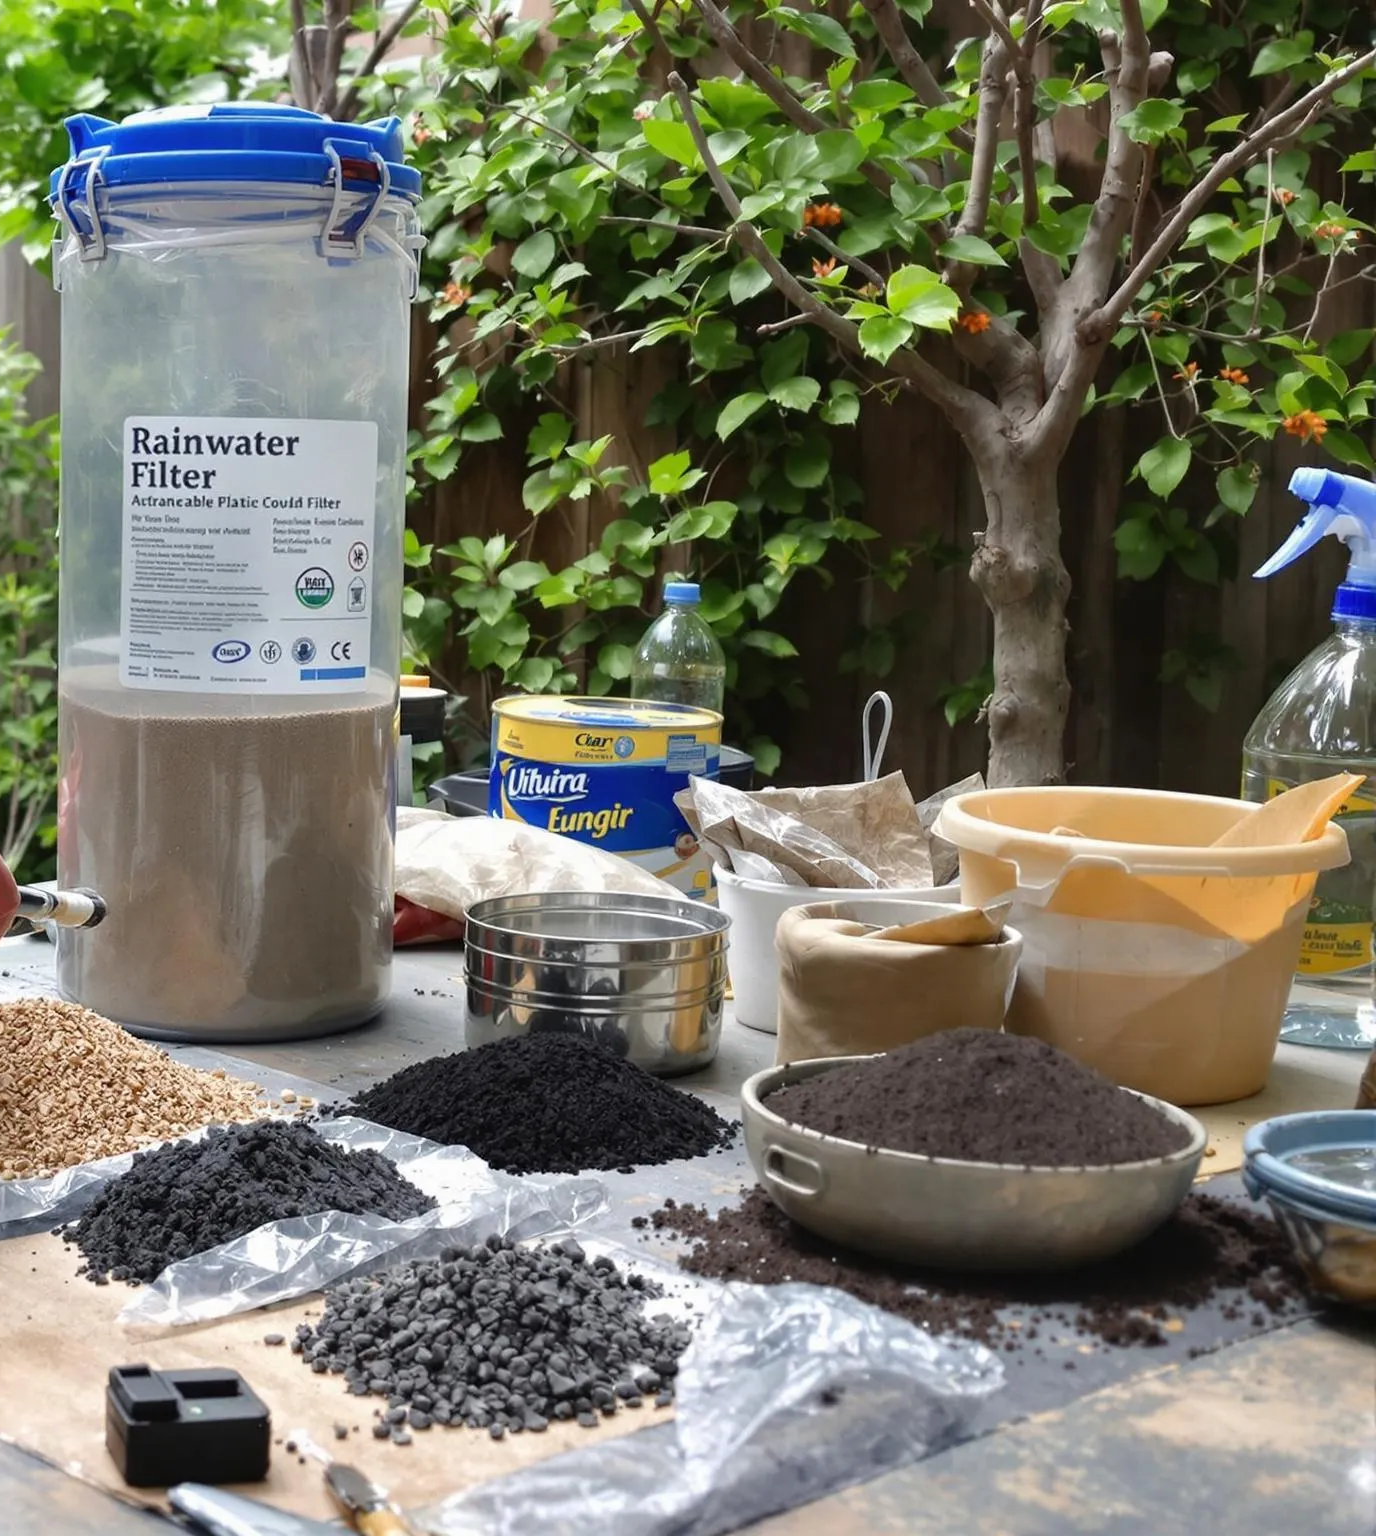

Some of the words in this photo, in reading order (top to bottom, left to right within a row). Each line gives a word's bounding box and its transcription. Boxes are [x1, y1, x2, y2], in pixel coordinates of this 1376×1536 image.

[131, 426, 300, 456] Rainwater
[130, 460, 216, 489] Filter
[330, 641, 352, 661] CE
